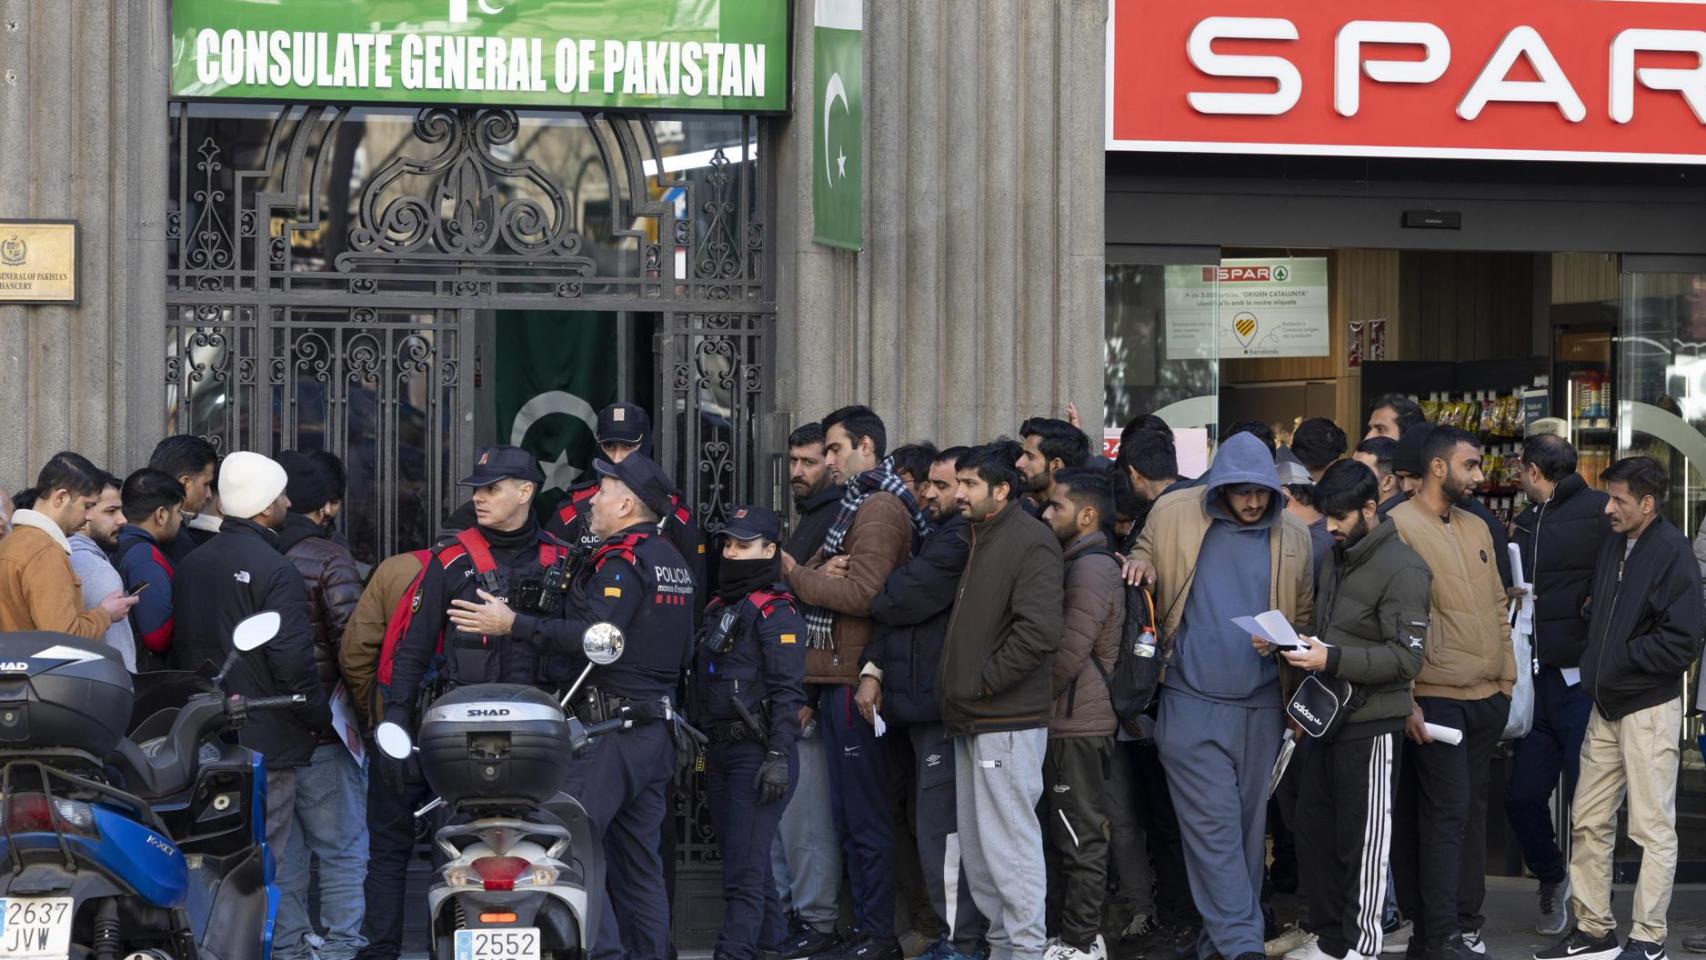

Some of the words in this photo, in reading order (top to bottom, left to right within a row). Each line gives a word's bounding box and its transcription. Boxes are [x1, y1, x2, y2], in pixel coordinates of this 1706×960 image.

[196, 28, 393, 88] CONSULATE
[400, 34, 547, 92] GENERAL
[555, 37, 596, 94] OF
[603, 40, 766, 98] PAKISTAN
[1186, 16, 1706, 125] SPAR
[37, 272, 68, 281] PAKISTAN
[1218, 268, 1270, 280] SPAR
[0, 282, 33, 290] HANCERY
[655, 565, 692, 584] POLICIA
[0, 662, 29, 671] HAD
[467, 708, 510, 717] SHAD
[1293, 701, 1315, 722] adidas
[8, 902, 69, 925] 2637
[6, 927, 50, 952] JVW
[475, 933, 535, 956] 2552
